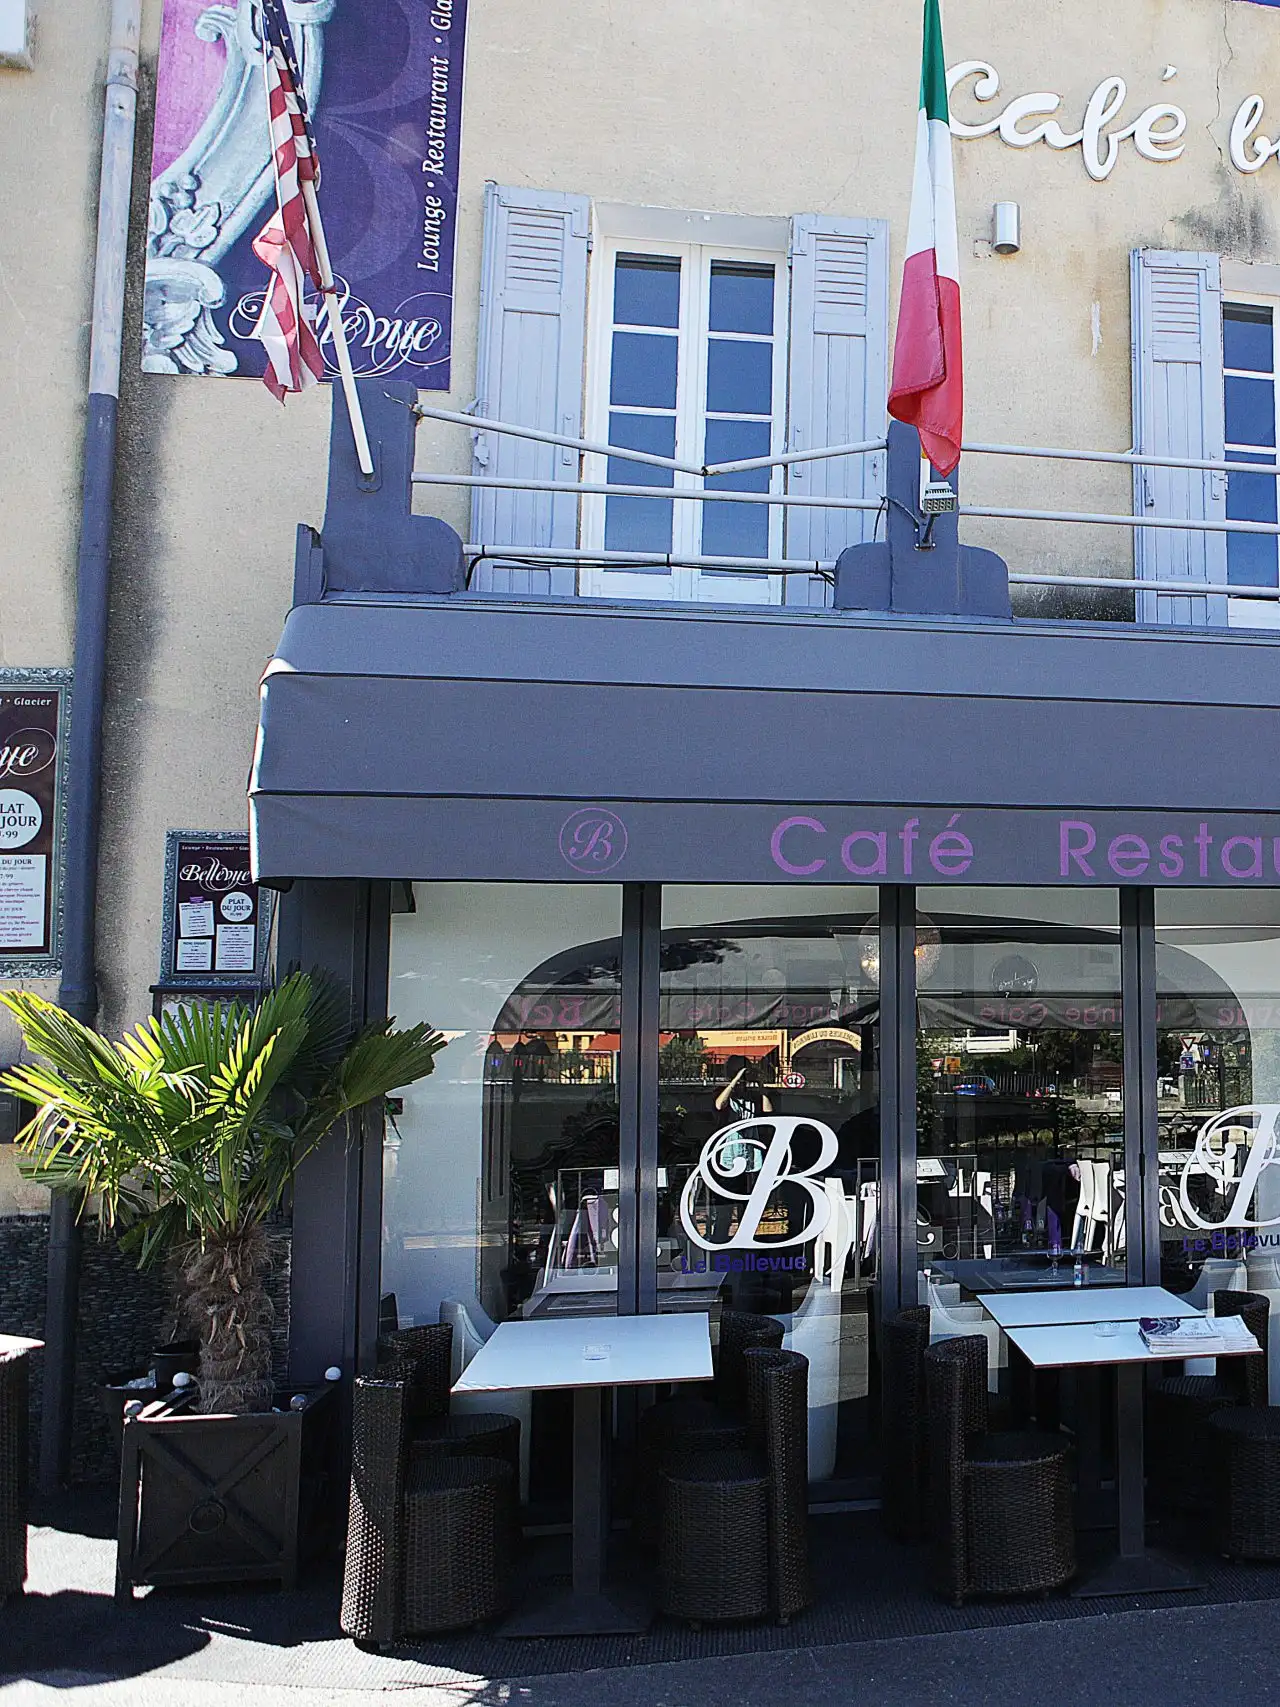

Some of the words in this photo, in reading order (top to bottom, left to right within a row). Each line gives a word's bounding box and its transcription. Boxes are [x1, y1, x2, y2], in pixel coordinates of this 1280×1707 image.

[422, 56, 450, 175] Restaurant
[945, 59, 1188, 182] Café
[417, 195, 446, 272] Lounge
[14, 697, 52, 706] Glacier
[179, 856, 251, 892] Bellevue
[770, 813, 974, 876] Café
[679, 1115, 848, 1274] B
[714, 1254, 807, 1273] Bellevue
[1183, 1236, 1206, 1252] Le
